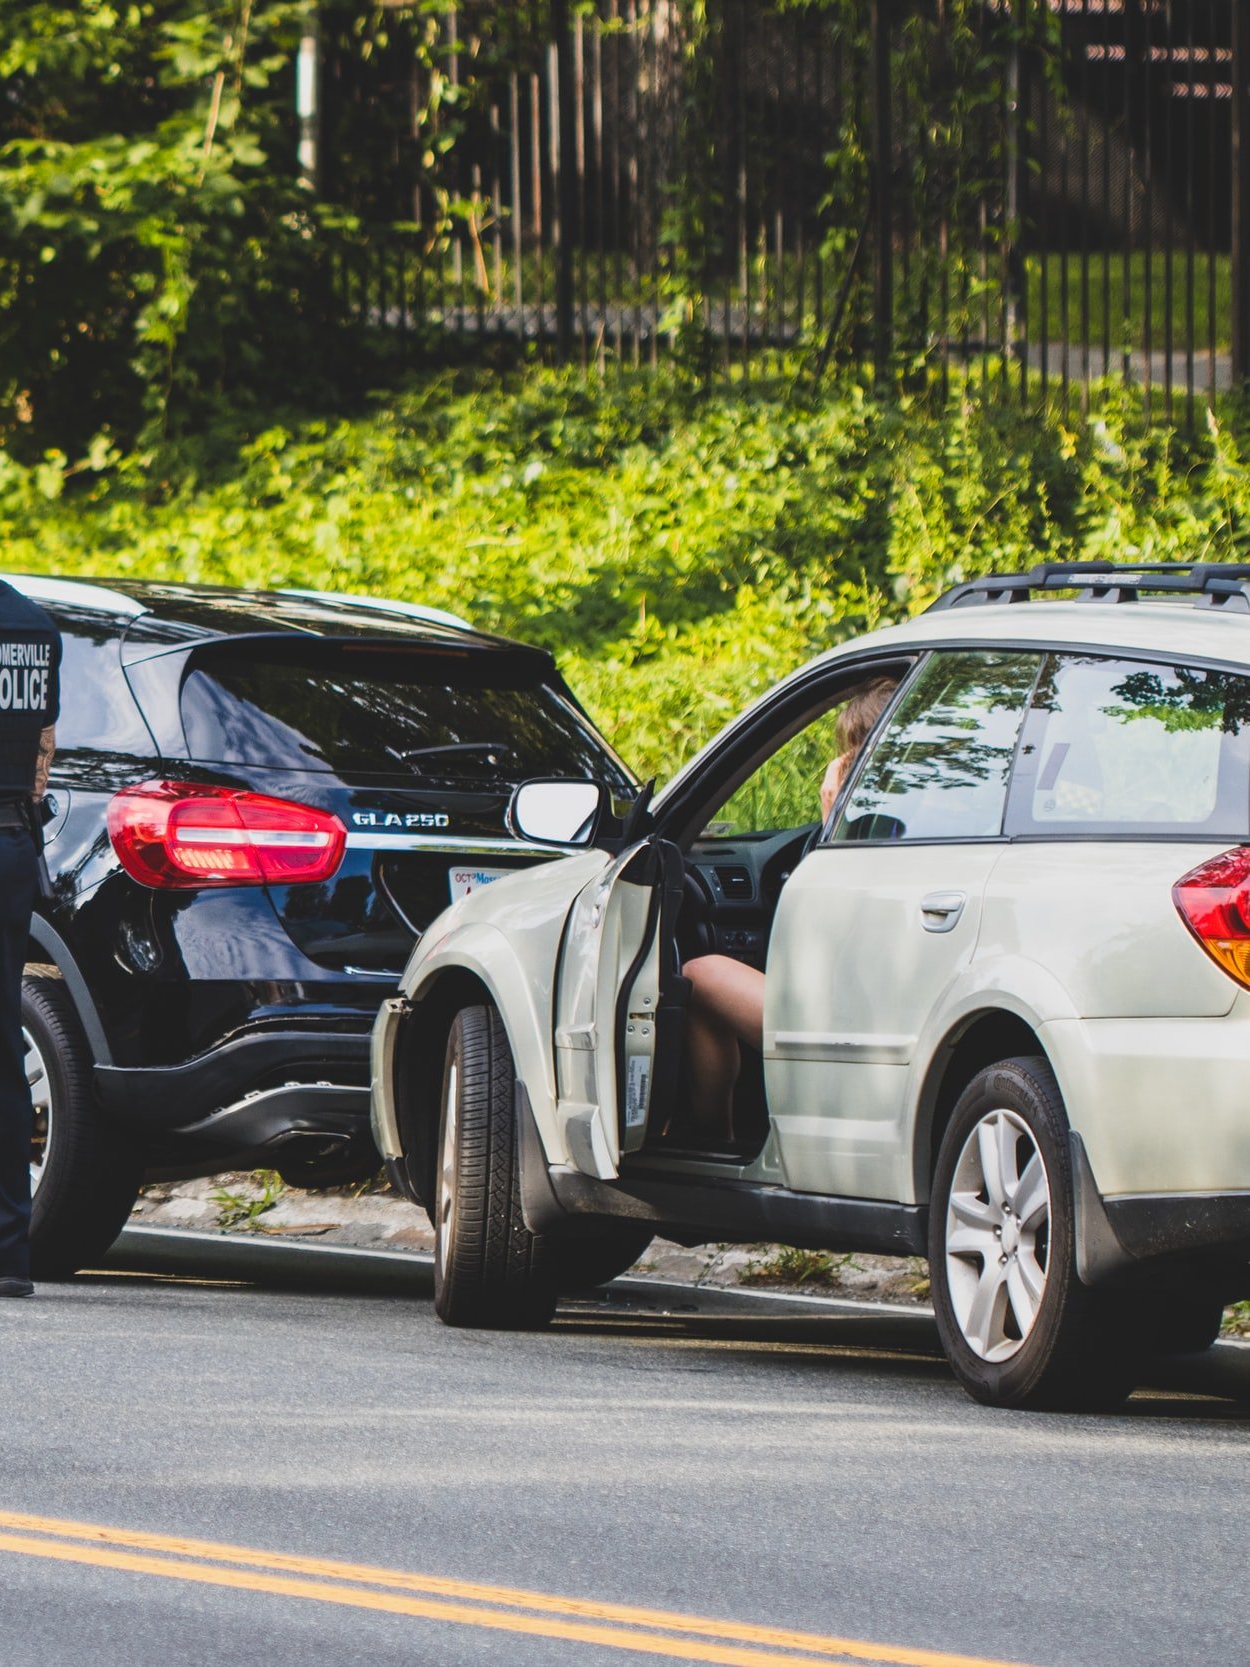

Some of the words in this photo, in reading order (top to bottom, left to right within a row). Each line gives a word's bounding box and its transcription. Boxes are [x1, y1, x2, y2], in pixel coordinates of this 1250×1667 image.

[352, 813, 402, 826] GLA
[405, 813, 449, 827] 250
[455, 873, 471, 883] OCT
